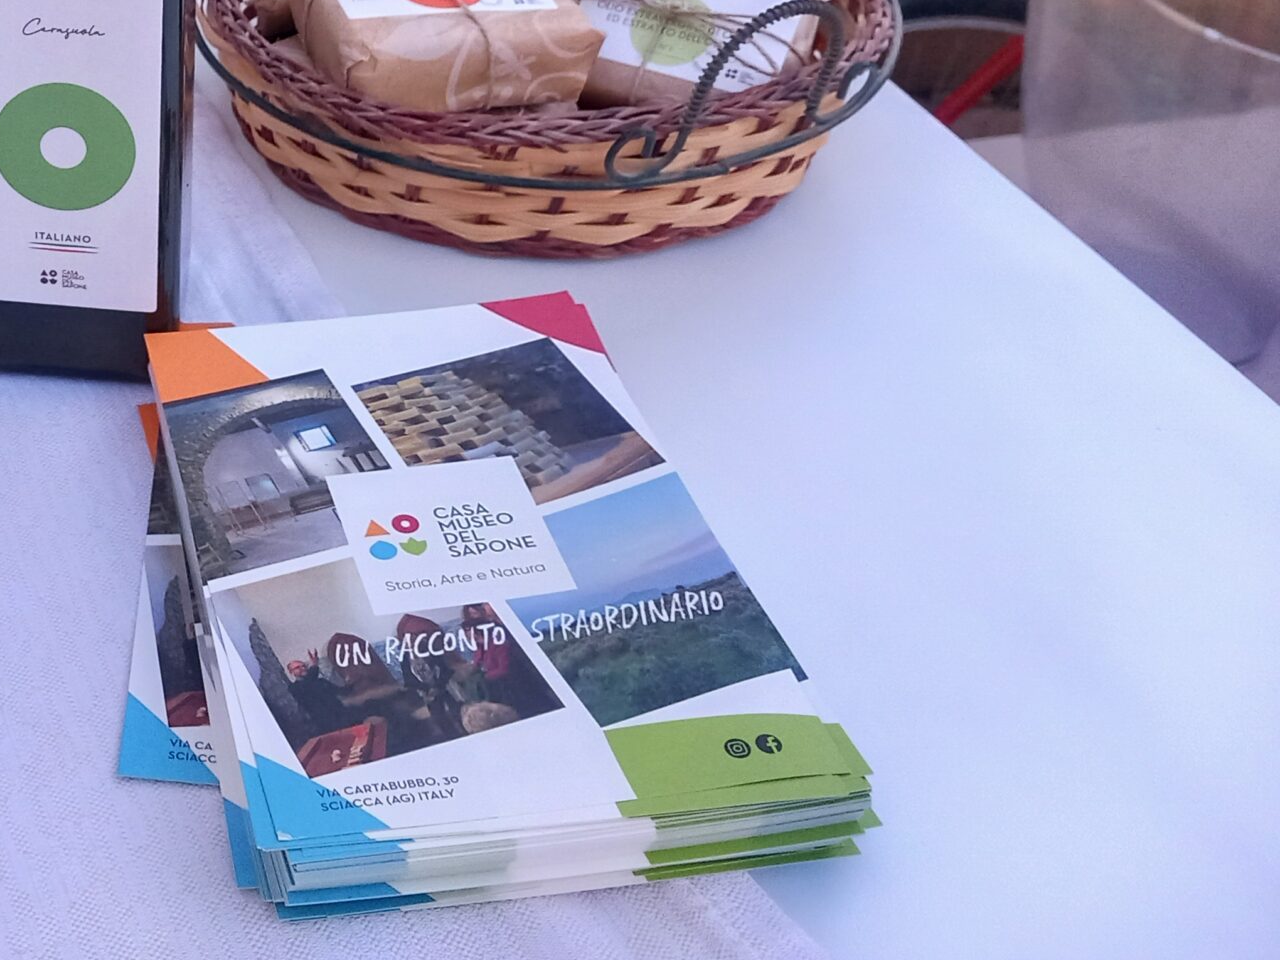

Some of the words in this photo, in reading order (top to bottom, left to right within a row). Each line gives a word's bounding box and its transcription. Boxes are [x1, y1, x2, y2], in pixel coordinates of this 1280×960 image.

[34, 231, 92, 244] ITALIANO
[433, 503, 490, 519] CASA
[437, 512, 514, 533] MUSEO
[442, 529, 486, 545] DEL
[448, 535, 537, 558] SAPONE
[385, 577, 437, 592] Storia,
[440, 572, 472, 585] Arte
[476, 572, 487, 581] e
[490, 563, 547, 579] Natura
[334, 642, 371, 668] UN
[385, 622, 507, 662] RACCONTO
[530, 590, 724, 643] STRAORDINARIO
[169, 738, 191, 748] VIA
[316, 788, 340, 799] VIA
[343, 777, 440, 795] CARTABUBBO,
[443, 776, 459, 785] 30
[321, 797, 384, 812] SCIACCA
[386, 793, 415, 806] (AG)
[418, 788, 454, 801] ITALY
